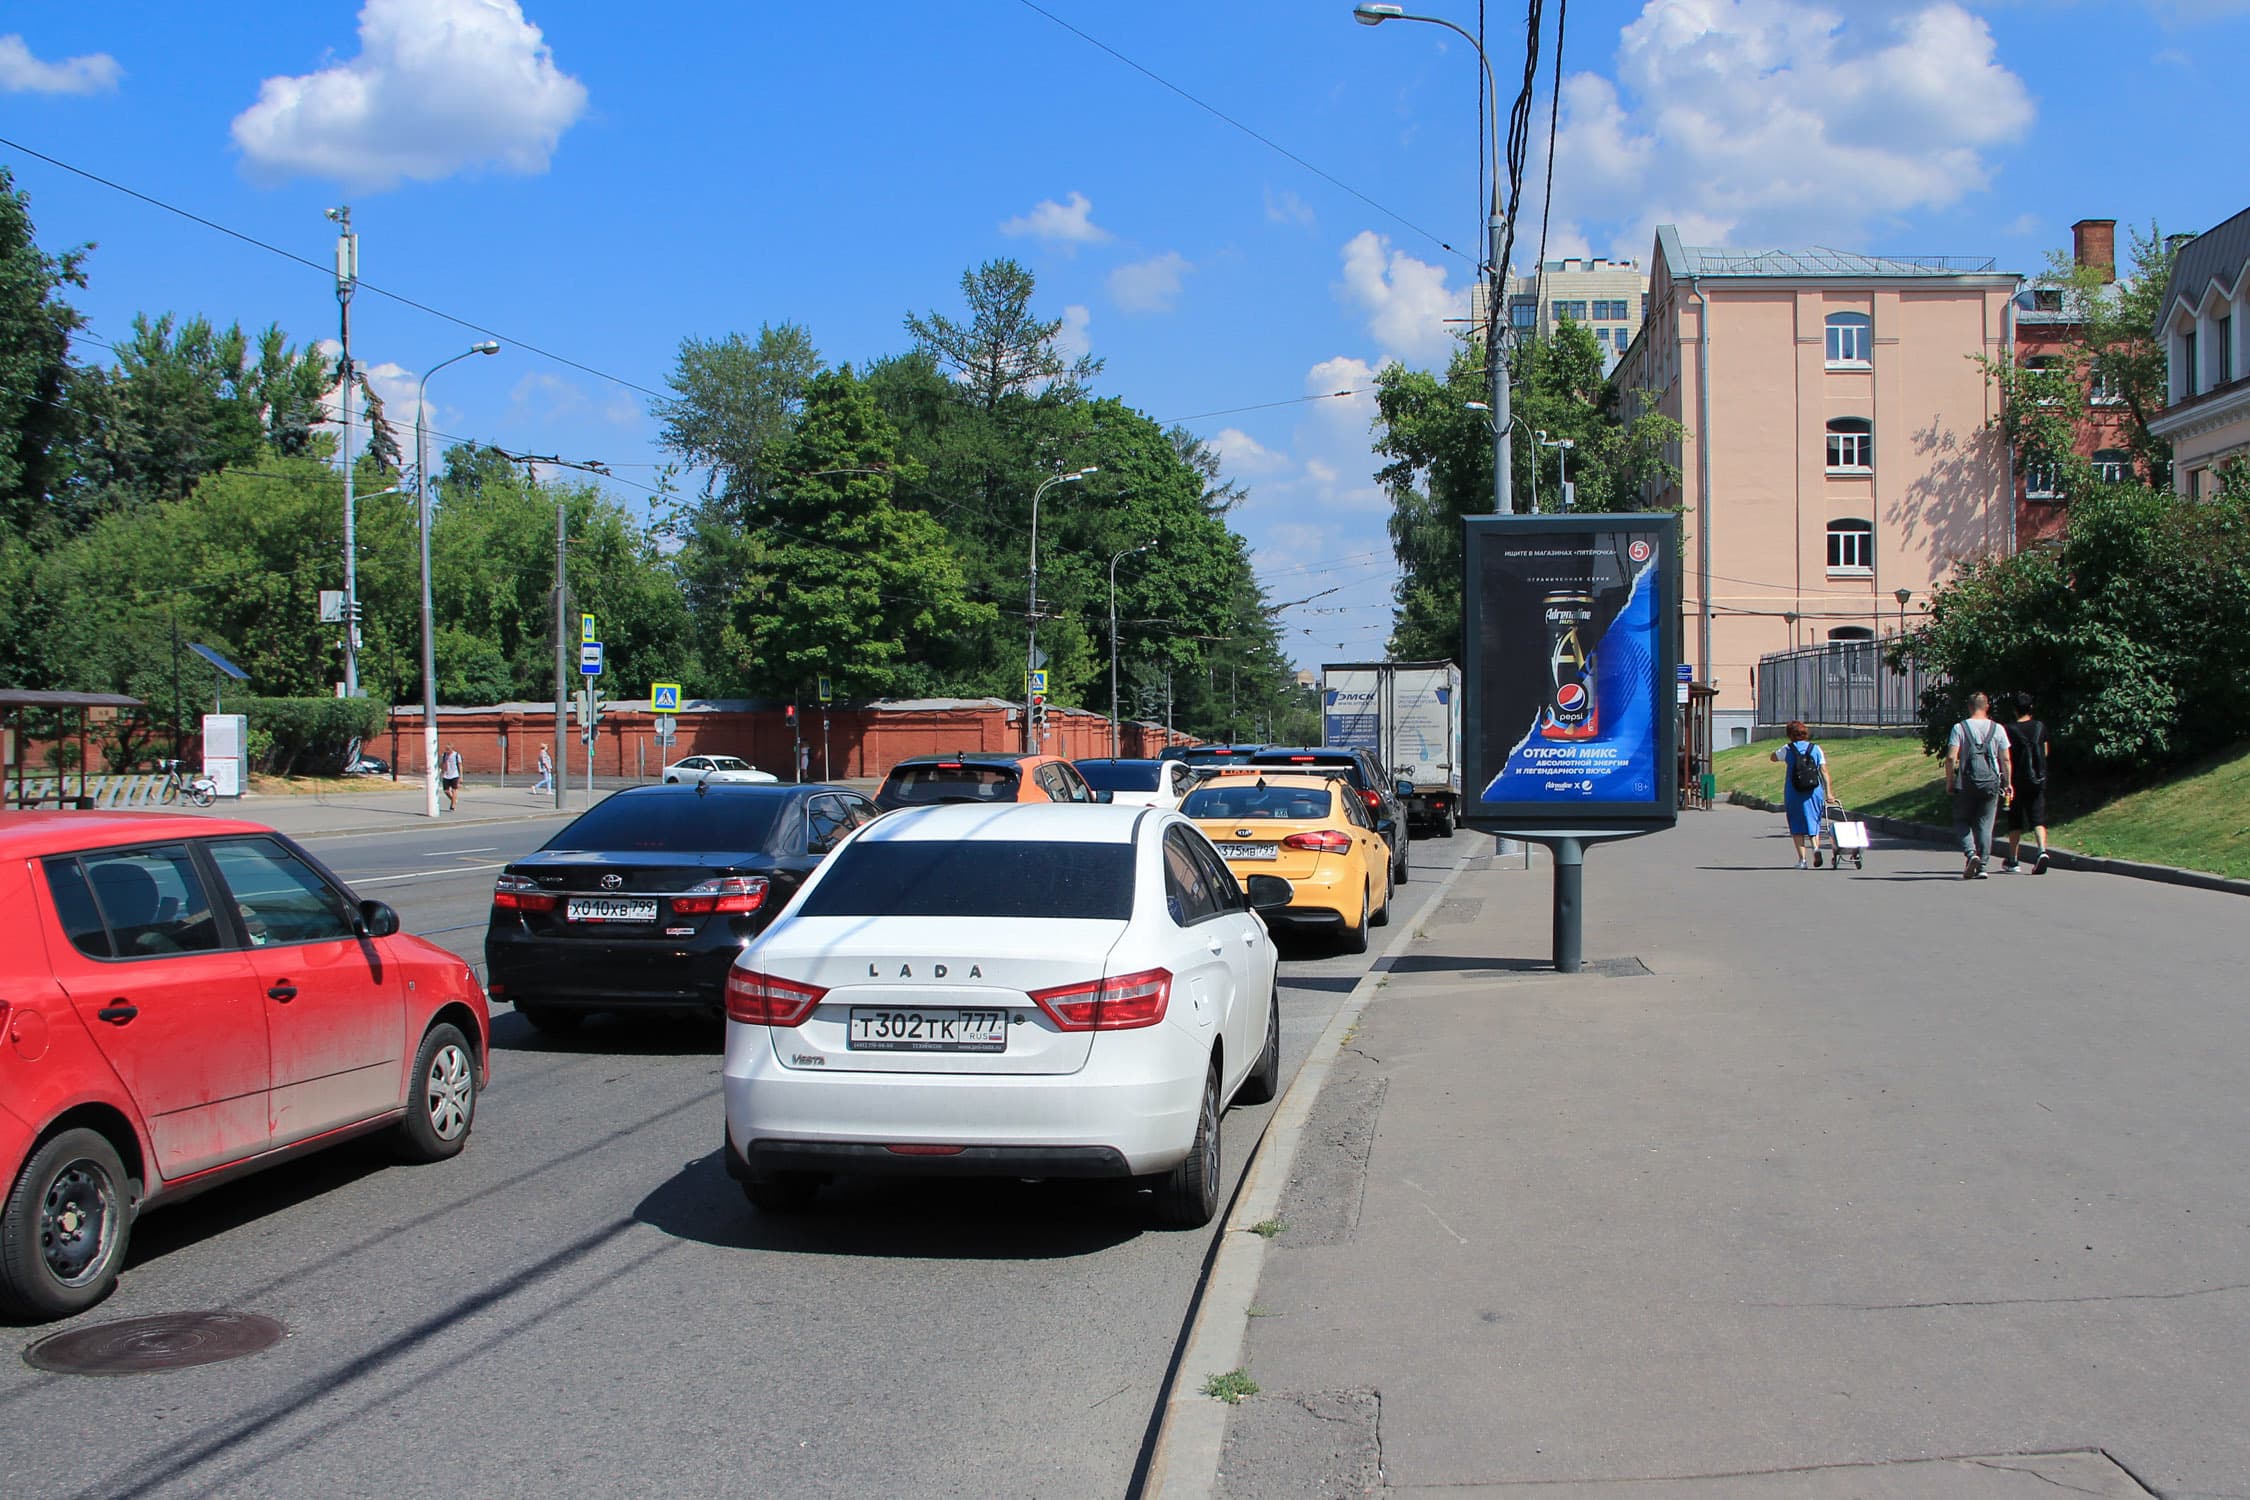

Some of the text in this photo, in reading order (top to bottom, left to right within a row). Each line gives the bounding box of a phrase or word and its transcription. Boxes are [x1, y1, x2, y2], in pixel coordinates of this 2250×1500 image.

[1559, 712, 1584, 722] pepsi
[1523, 747, 1618, 758] ОТКРОЙ МИКС
[1634, 783, 1648, 791] 18+
[1217, 845, 1256, 856] 375МВ
[632, 900, 653, 913] 799
[869, 963, 982, 978] LADA
[961, 1012, 999, 1033] 777
[969, 1032, 988, 1040] RUS
